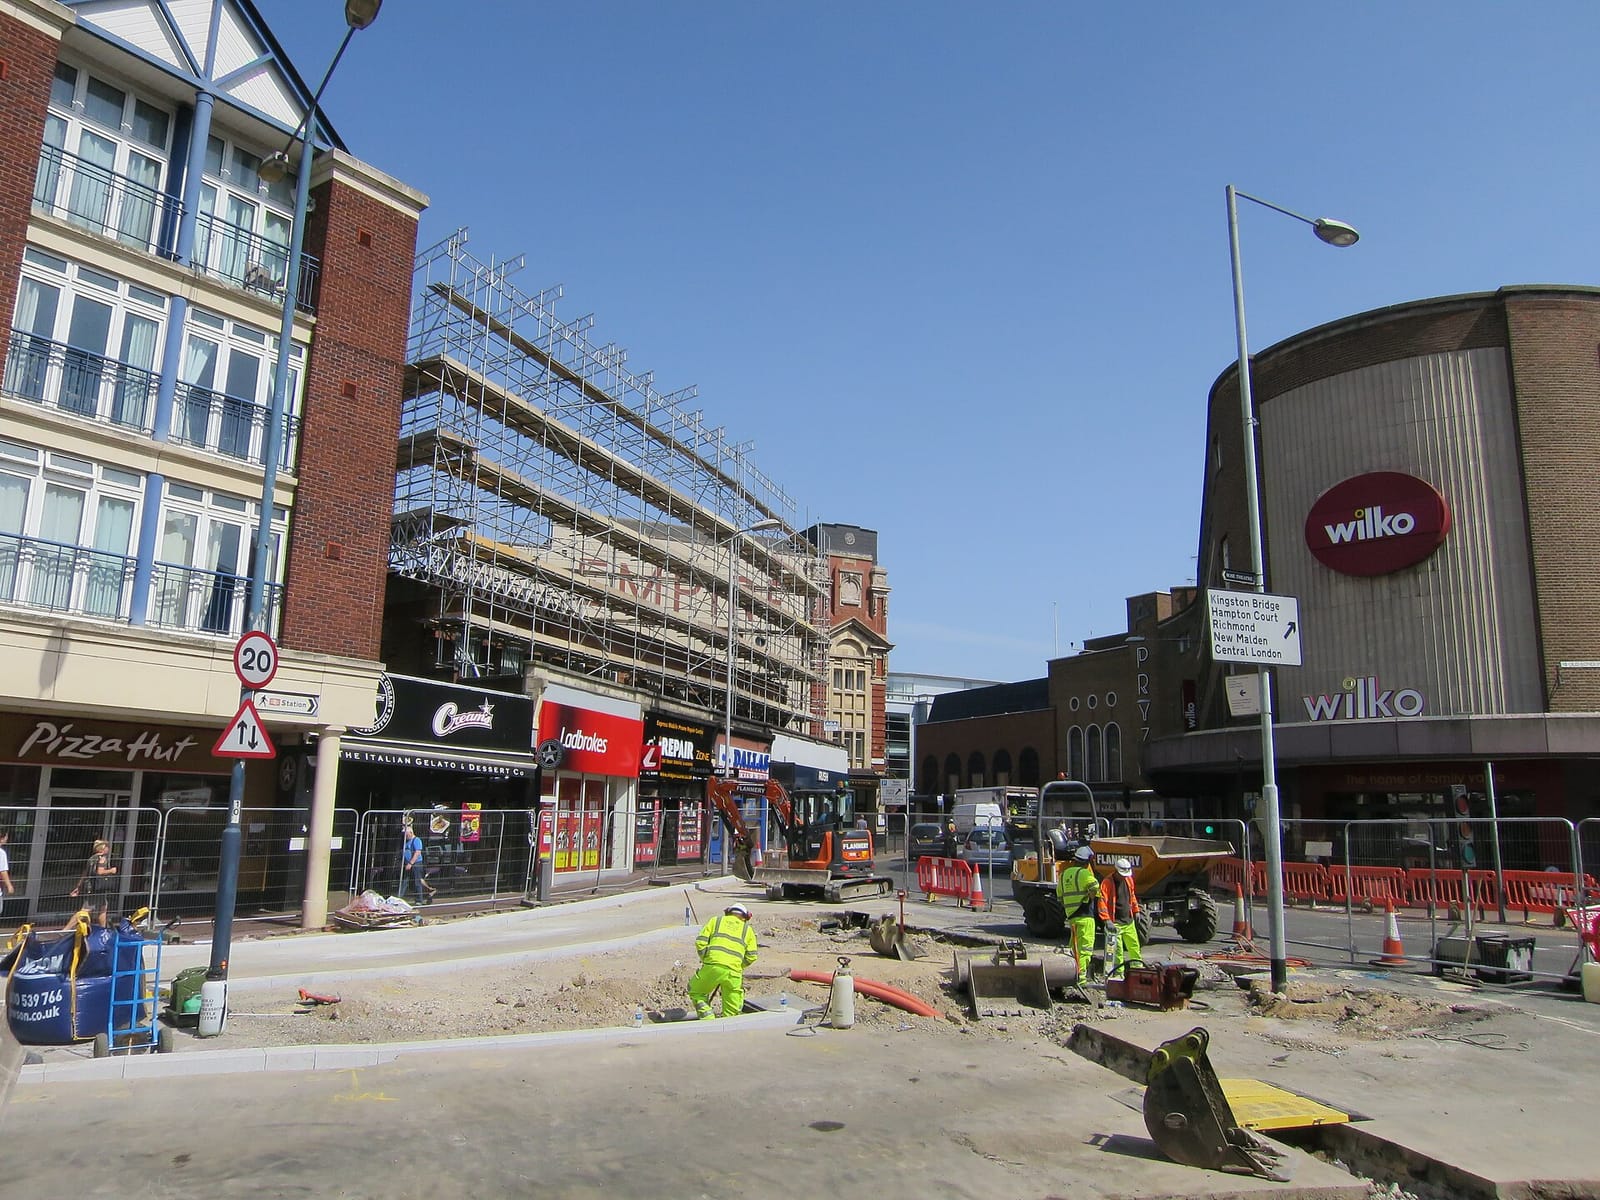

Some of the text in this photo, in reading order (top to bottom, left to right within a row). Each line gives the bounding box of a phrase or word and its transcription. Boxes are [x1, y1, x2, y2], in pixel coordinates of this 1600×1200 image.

[1324, 506, 1415, 544] wilko
[1210, 595, 1280, 611] Kingston Bridge
[1211, 607, 1279, 622] Hampton Court
[1212, 620, 1256, 632] Richmond
[1213, 632, 1268, 645] New Malden
[1215, 644, 1282, 658] Central London
[242, 648, 271, 673] 20
[281, 699, 307, 708] Station
[1303, 676, 1425, 721] wilko
[1184, 702, 1197, 729] wilko
[18, 722, 199, 762] Pizza Hut
[560, 727, 608, 753] Ladbrokes
[339, 750, 361, 760] THE
[365, 752, 411, 765] ITALIAN
[415, 757, 456, 769] GELATO
[468, 763, 510, 775] DESSERT
[695, 750, 710, 761] ZONE
[733, 749, 770, 772] DALLAS
[1468, 774, 1505, 784] vae
[736, 785, 765, 794] FLANNERY
[22, 993, 39, 1008] 539
[41, 988, 63, 1005] 766
